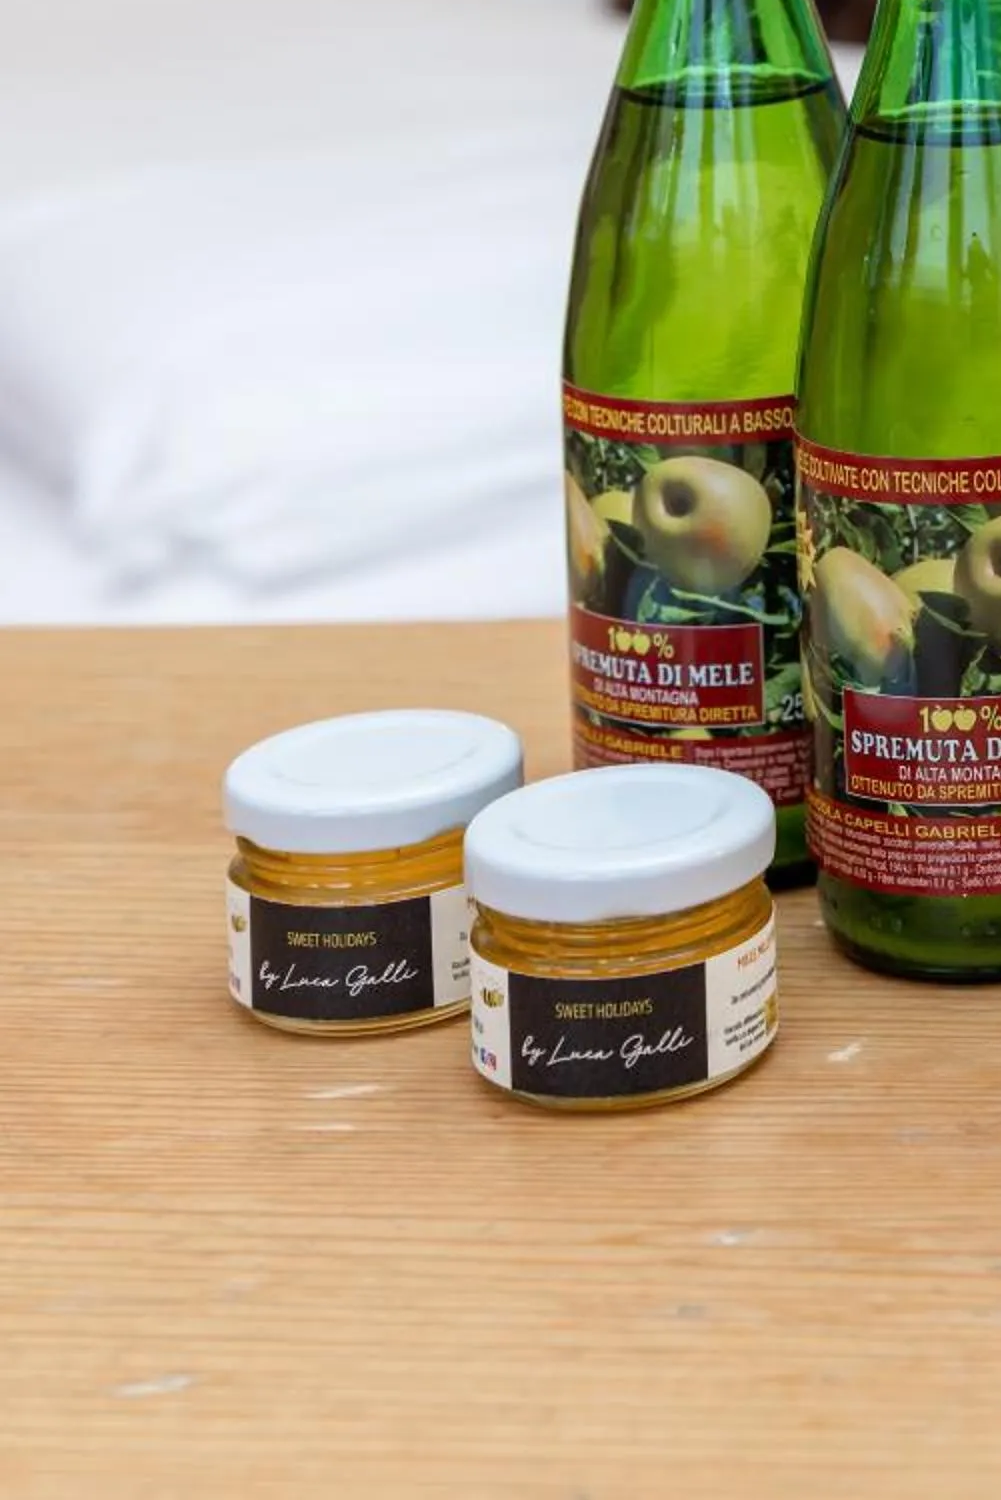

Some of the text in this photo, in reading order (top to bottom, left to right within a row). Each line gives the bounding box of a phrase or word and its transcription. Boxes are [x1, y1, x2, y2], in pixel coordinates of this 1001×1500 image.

[648, 412, 727, 435] COLTURALI
[729, 413, 741, 434] A
[743, 407, 793, 431] BASSO
[860, 467, 889, 492] CON
[893, 471, 970, 494] TECNICHE
[573, 643, 754, 687] PREMUTA DI MELE
[630, 685, 700, 706] MONTAGNA
[700, 705, 758, 723] DIRETTA
[851, 729, 979, 763] SPREMUTA
[899, 764, 912, 780] DI
[915, 765, 948, 783] ALTA
[850, 774, 913, 799] OTTENUTO
[916, 784, 935, 799] DA
[844, 814, 910, 837] CAPELLI
[287, 931, 378, 949] SWEET HOLIDAYS
[259, 960, 280, 990] by
[279, 963, 340, 990] Luca
[345, 958, 420, 996] Galli
[555, 998, 653, 1019] SWEET HOLIDAYS
[521, 1035, 546, 1066] by
[546, 1036, 615, 1066] Luca
[619, 1025, 695, 1069] Galli
